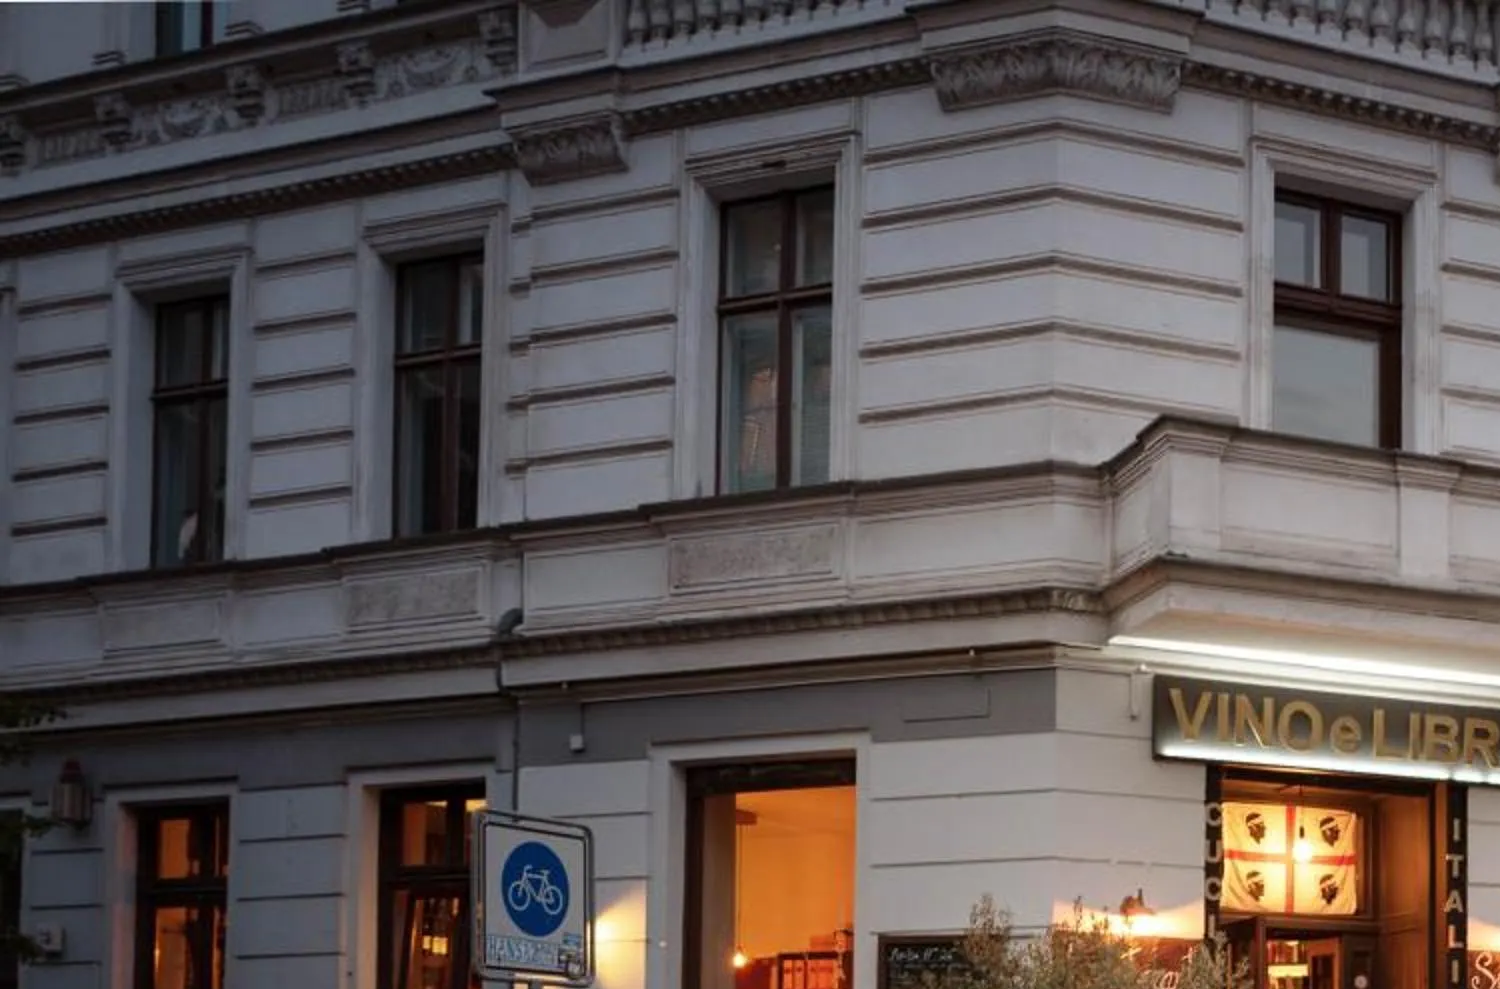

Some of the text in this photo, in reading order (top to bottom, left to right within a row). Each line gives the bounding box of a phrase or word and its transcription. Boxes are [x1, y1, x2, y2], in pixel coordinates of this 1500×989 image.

[1169, 687, 1324, 754] VINO
[1329, 715, 1363, 756] e
[1204, 802, 1221, 939] CUCI
